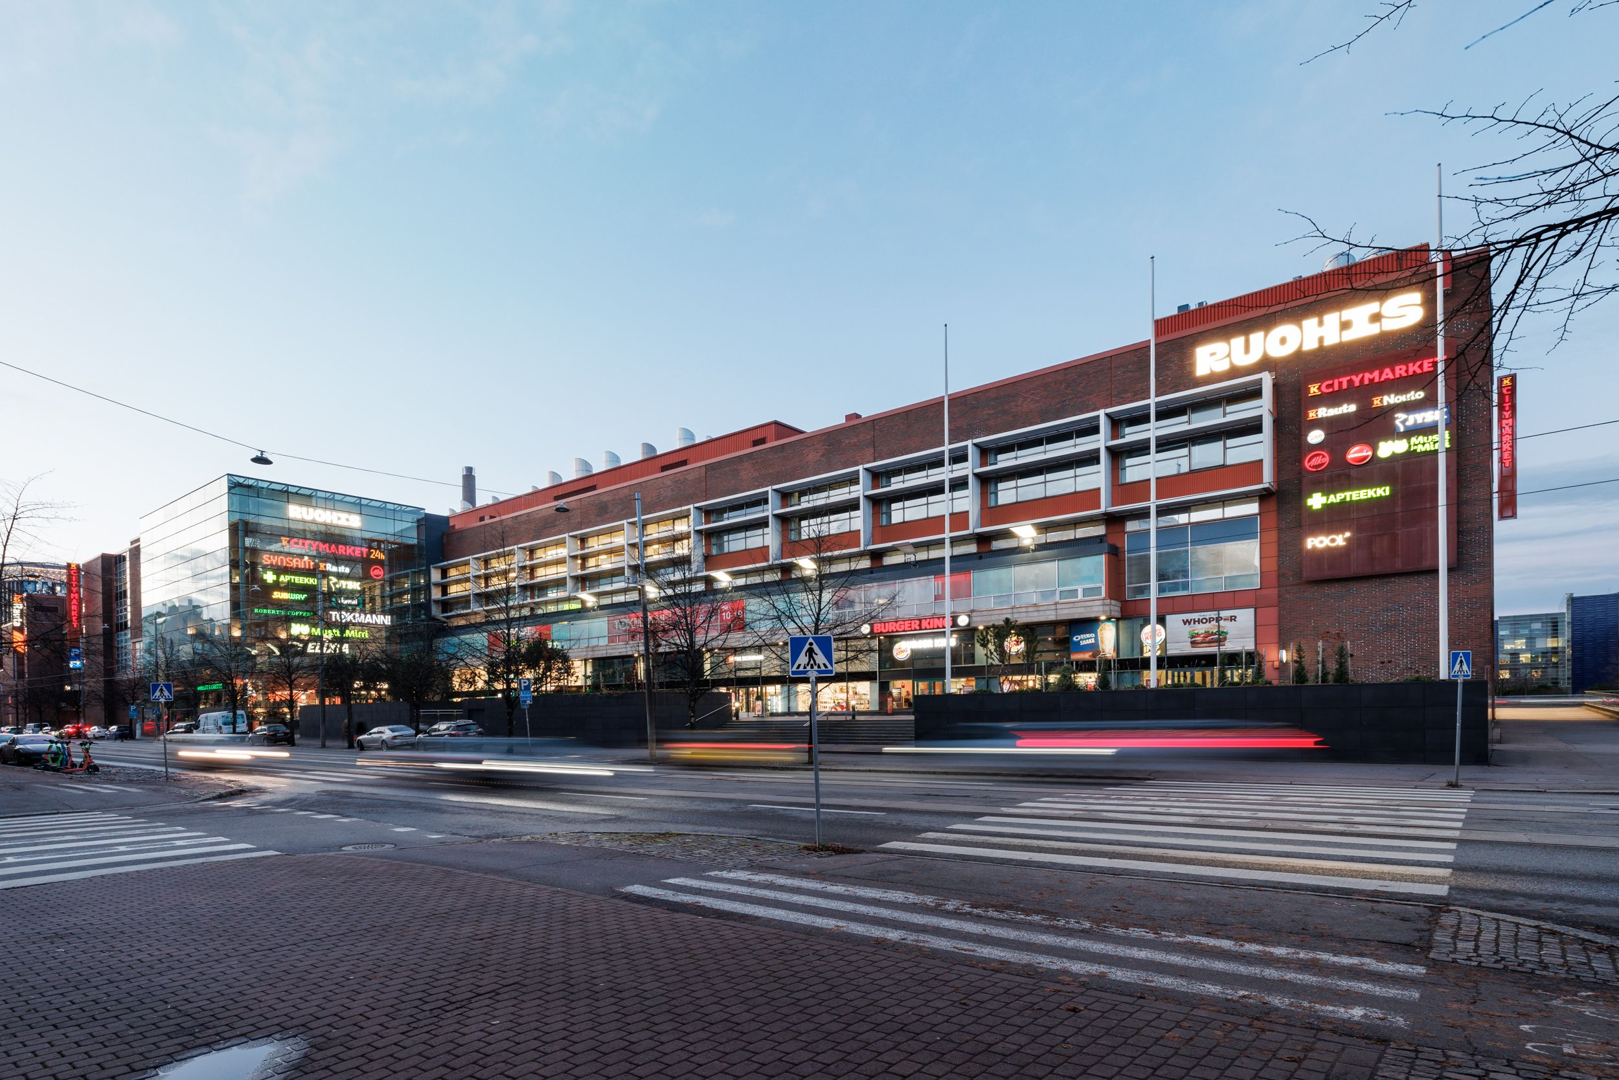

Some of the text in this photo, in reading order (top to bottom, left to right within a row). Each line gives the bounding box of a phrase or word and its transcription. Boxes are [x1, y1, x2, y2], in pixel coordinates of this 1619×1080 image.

[1195, 292, 1424, 376] RUOHIS
[1327, 485, 1390, 504] APTEEKKI
[287, 504, 362, 528] RUOHIS
[369, 549, 385, 560] 24h
[279, 574, 318, 585] APTEEKKI
[271, 591, 308, 601] SUBWAY
[873, 618, 920, 634] BURGER
